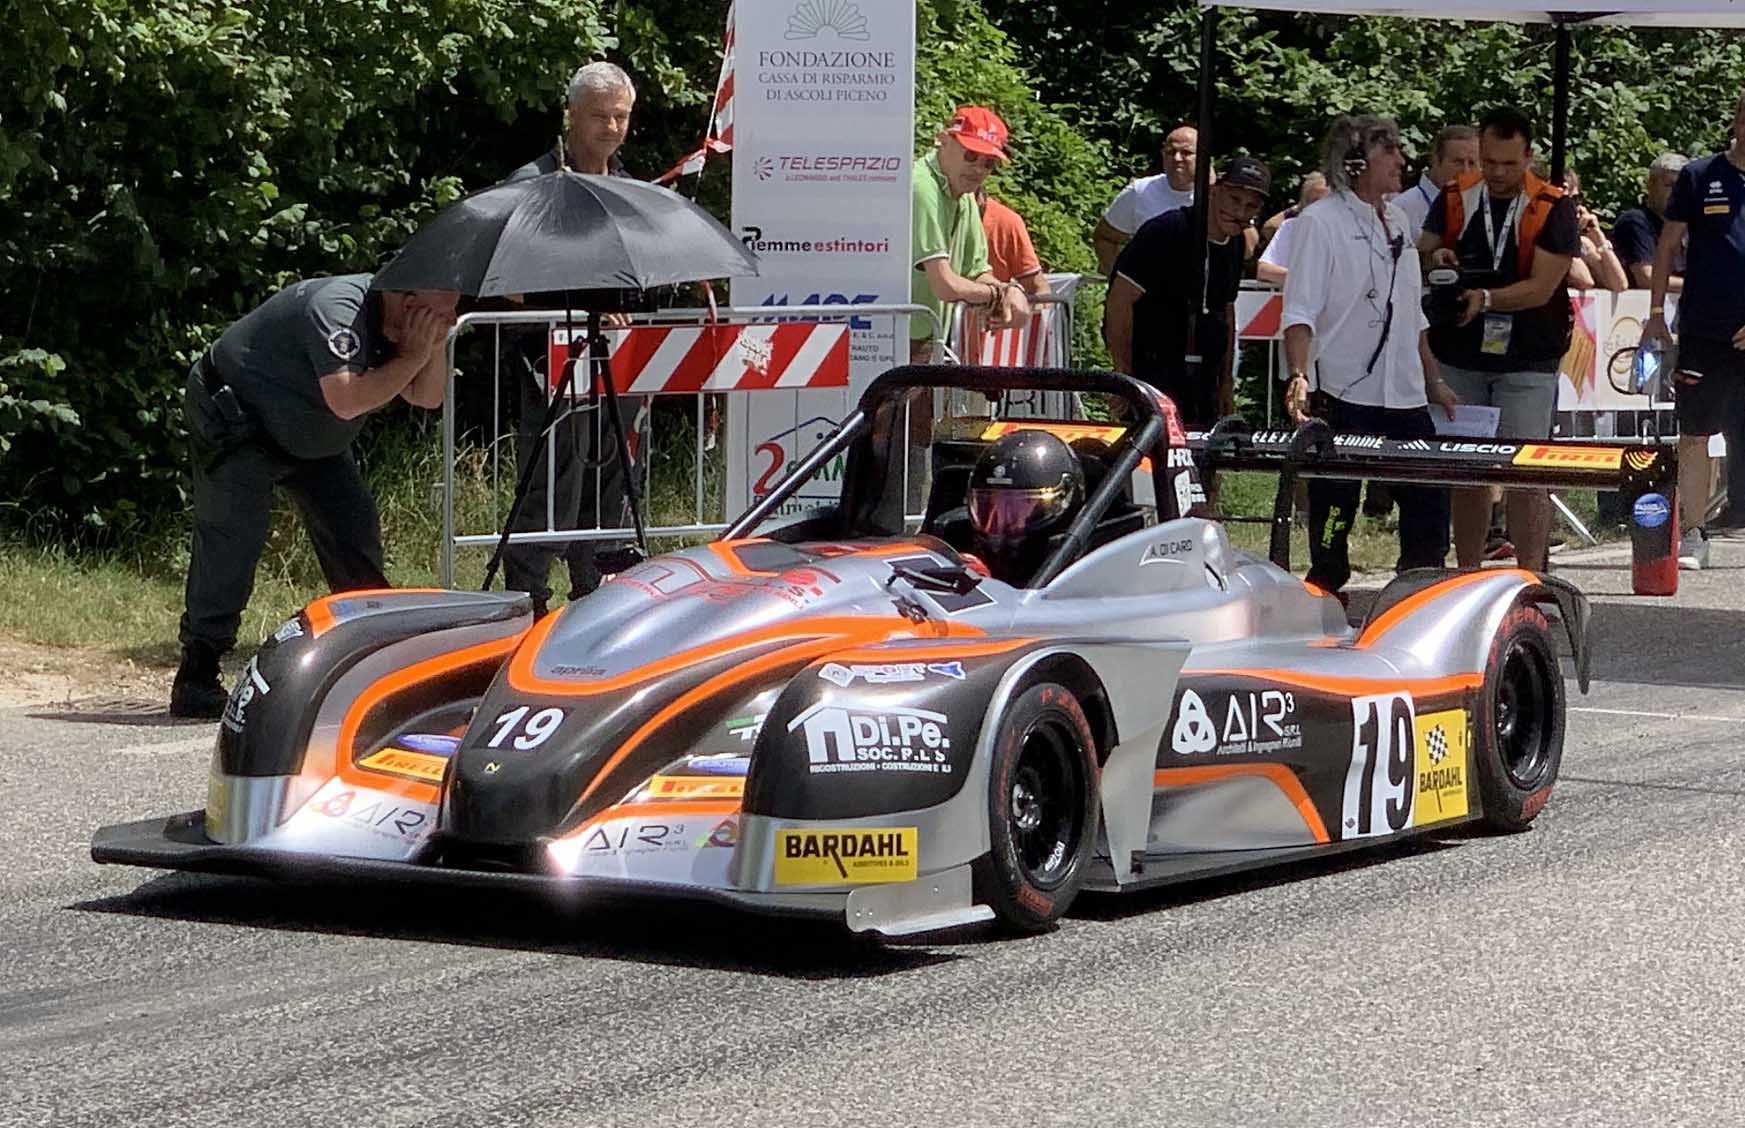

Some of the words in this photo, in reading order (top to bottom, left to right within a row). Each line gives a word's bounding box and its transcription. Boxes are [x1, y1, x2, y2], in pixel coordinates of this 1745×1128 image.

[759, 51, 896, 69] FONDAZIONE
[758, 72, 798, 84] CASSA
[802, 73, 818, 84] DI
[822, 73, 896, 85] RISPARMIO
[766, 90, 781, 101] DI
[786, 90, 833, 101] ASCOLI
[836, 90, 888, 102] PICENO
[780, 156, 901, 171] TELESPAZIO
[814, 237, 889, 252] estintori
[1439, 443, 1517, 454] LISCIO
[487, 706, 564, 750] 19
[1357, 696, 1415, 832] 19
[1419, 766, 1463, 804] BARDAHL
[785, 833, 909, 872] BARDAHL
